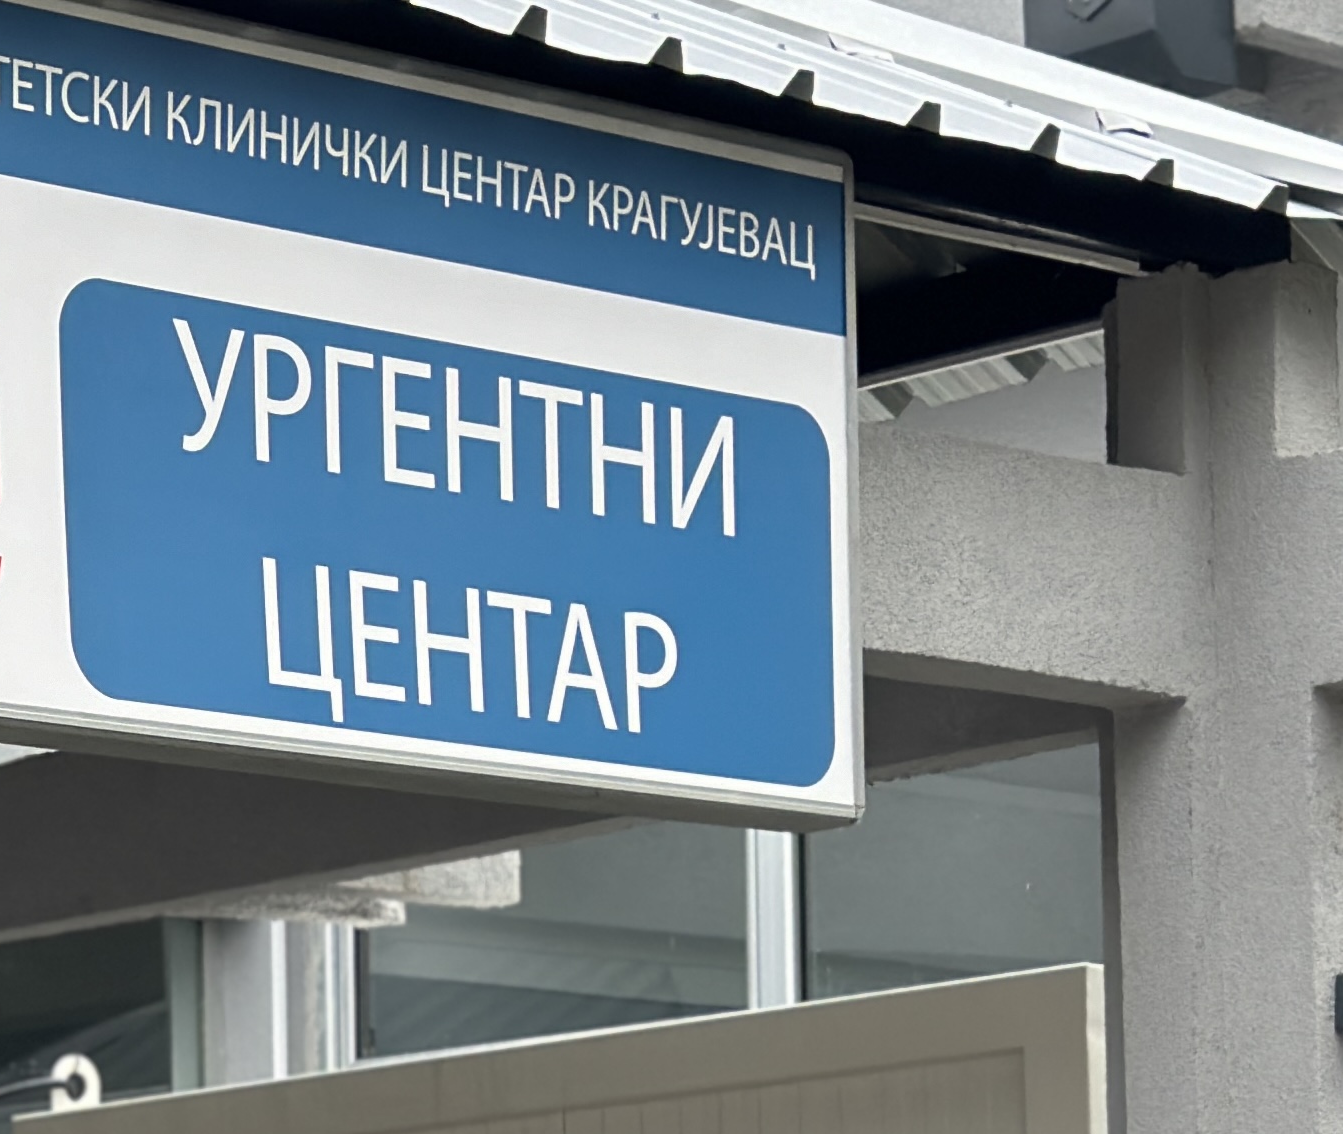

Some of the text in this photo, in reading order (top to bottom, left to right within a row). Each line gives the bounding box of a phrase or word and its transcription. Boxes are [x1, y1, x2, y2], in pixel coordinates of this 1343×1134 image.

[167, 91, 408, 188] КЛИНИЧКИ
[422, 144, 576, 220] ЦЕНТАР
[587, 179, 817, 281] КРАГУЈЕВАЦ
[173, 317, 737, 537] УРГЕНТНИ
[261, 556, 679, 733] ЦЕНТАР
